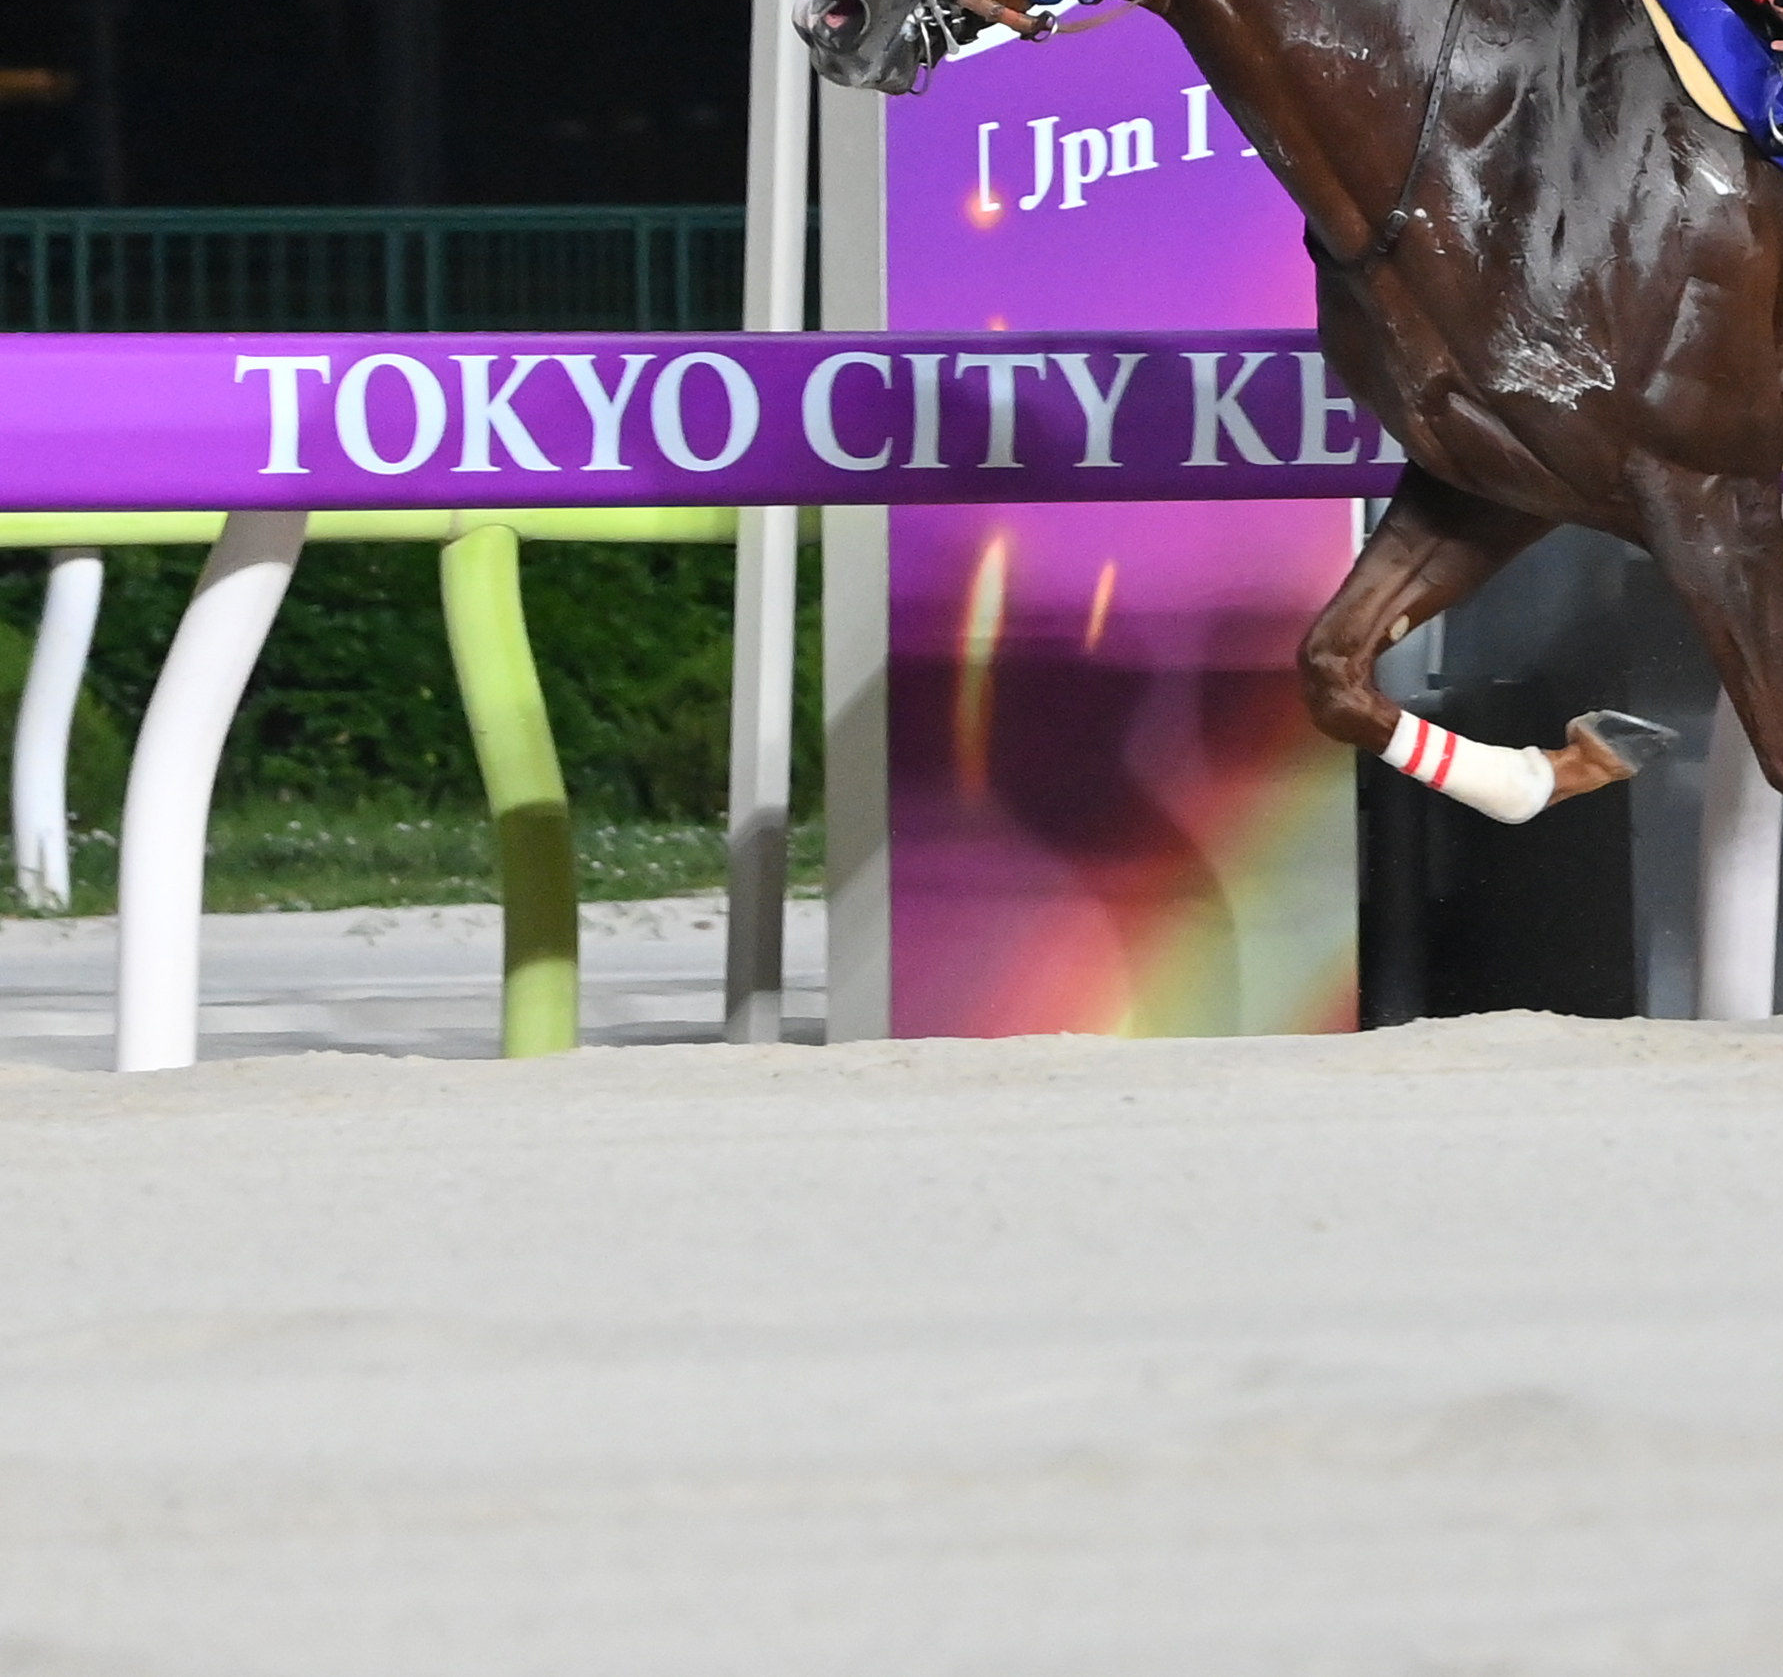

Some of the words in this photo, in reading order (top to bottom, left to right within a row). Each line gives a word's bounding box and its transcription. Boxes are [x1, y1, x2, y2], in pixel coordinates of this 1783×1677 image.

[233, 352, 760, 476] TOKYO
[800, 351, 1149, 471] CITY
[1178, 351, 1409, 467] KE
